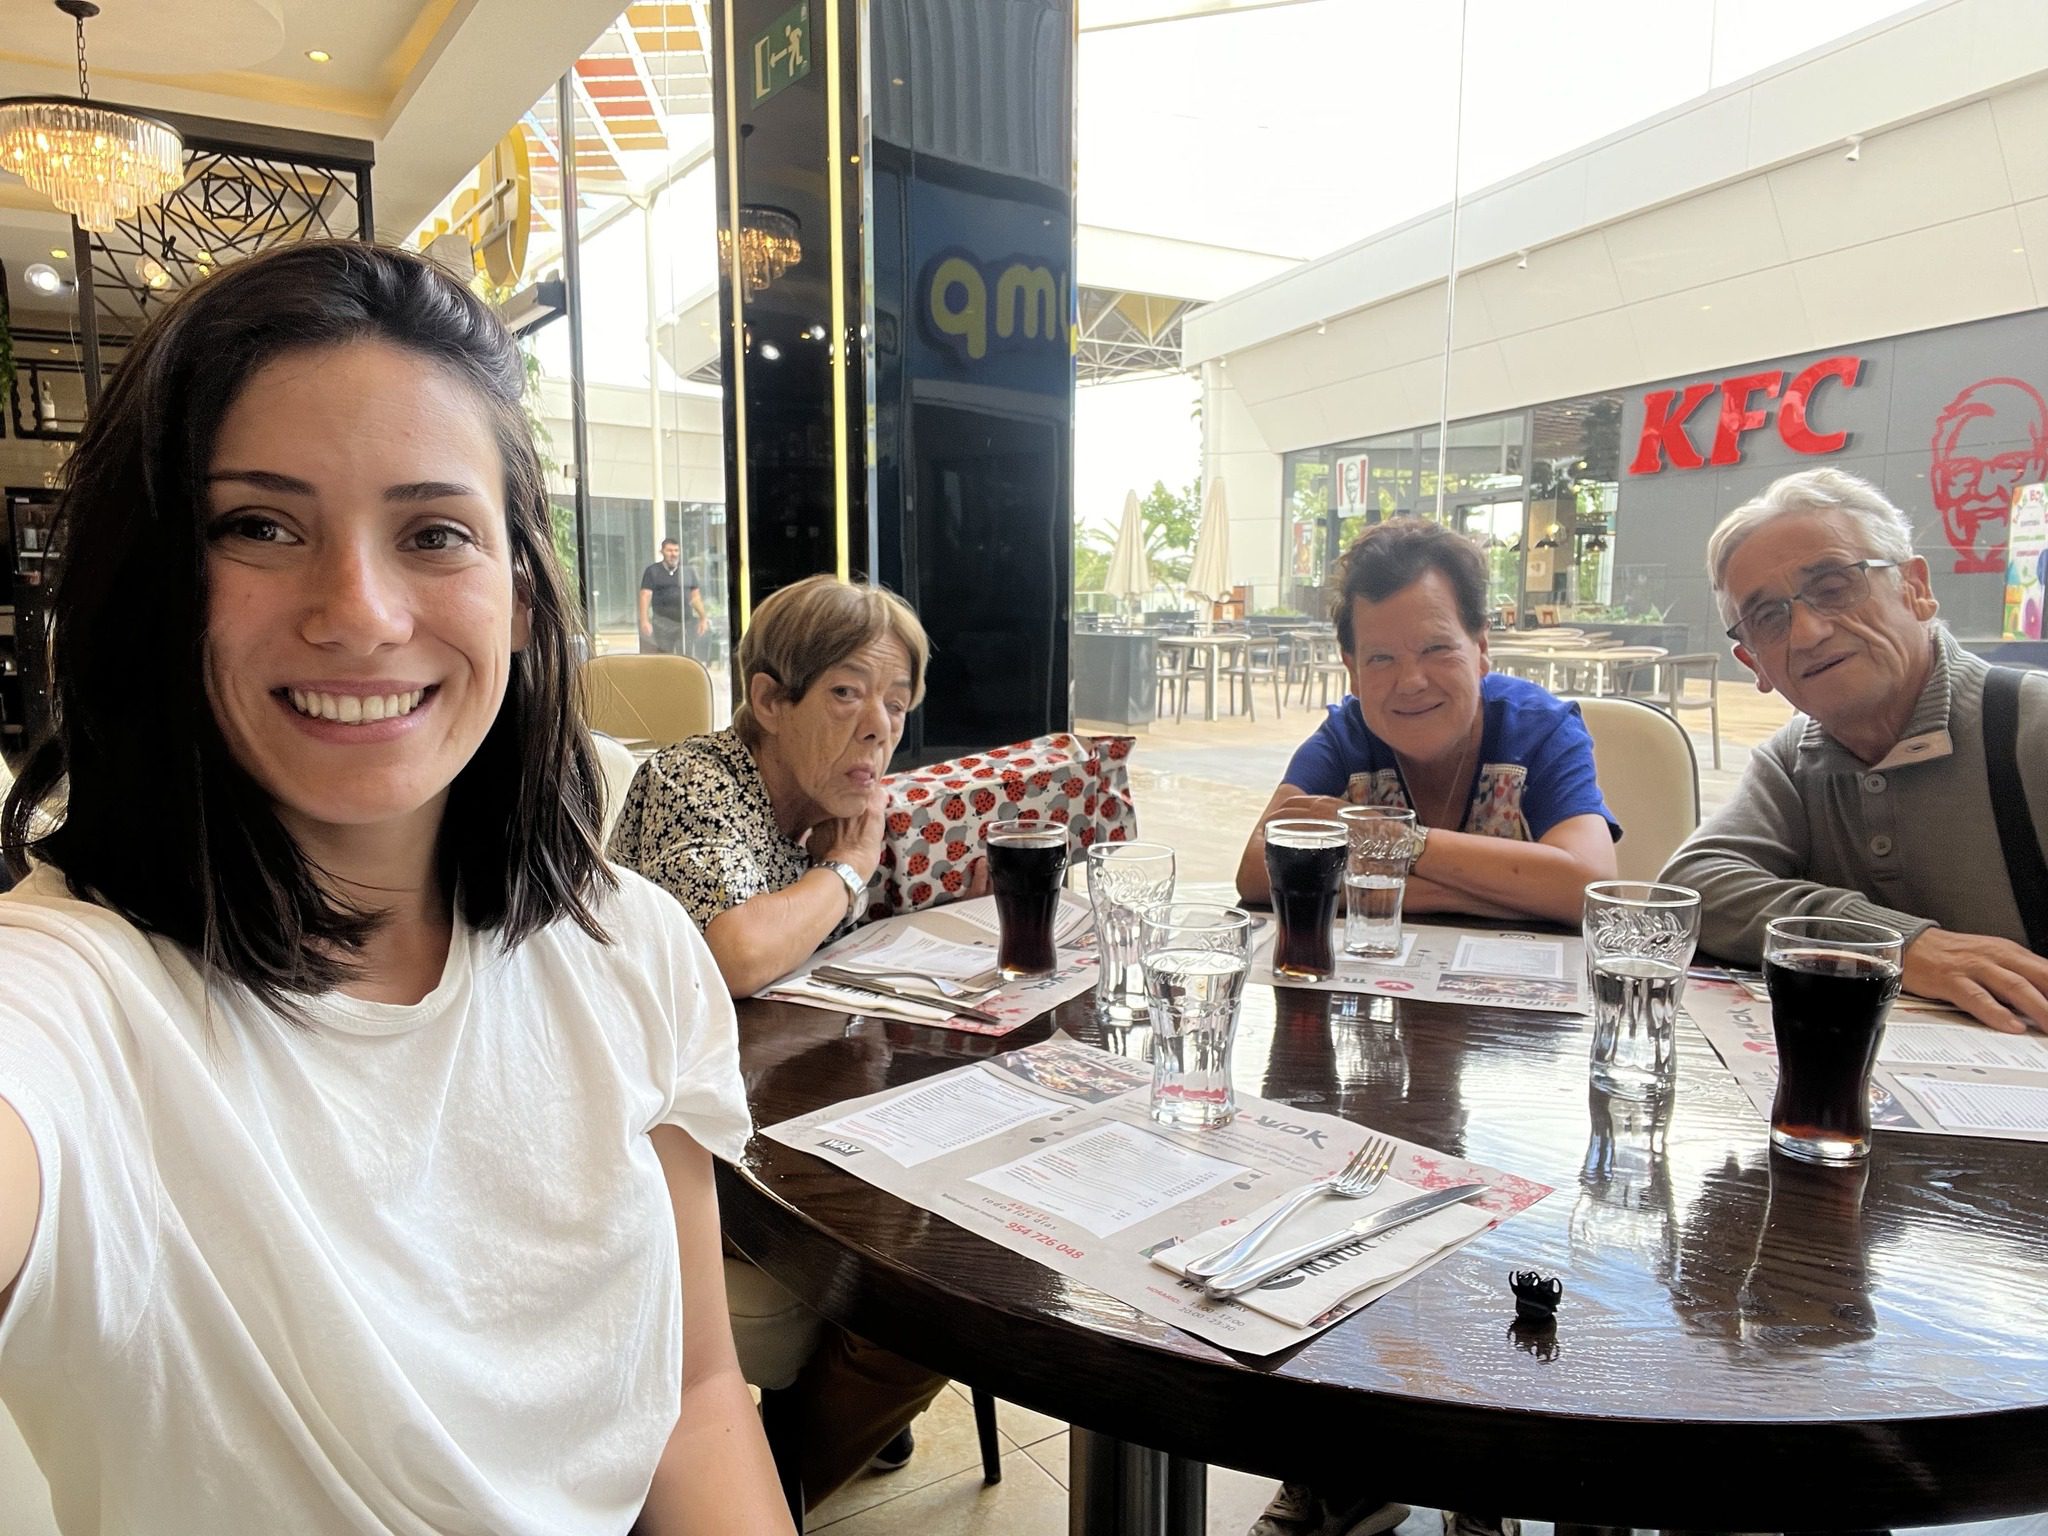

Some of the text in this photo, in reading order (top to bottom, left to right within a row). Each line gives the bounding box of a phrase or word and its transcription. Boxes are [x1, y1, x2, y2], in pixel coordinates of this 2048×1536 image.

[1628, 355, 1862, 475] KFC
[823, 1139, 861, 1154] WAY
[981, 1197, 1012, 1212] todos
[1007, 1202, 1051, 1220] Abierto
[1005, 1222, 1085, 1260] 954 726 048
